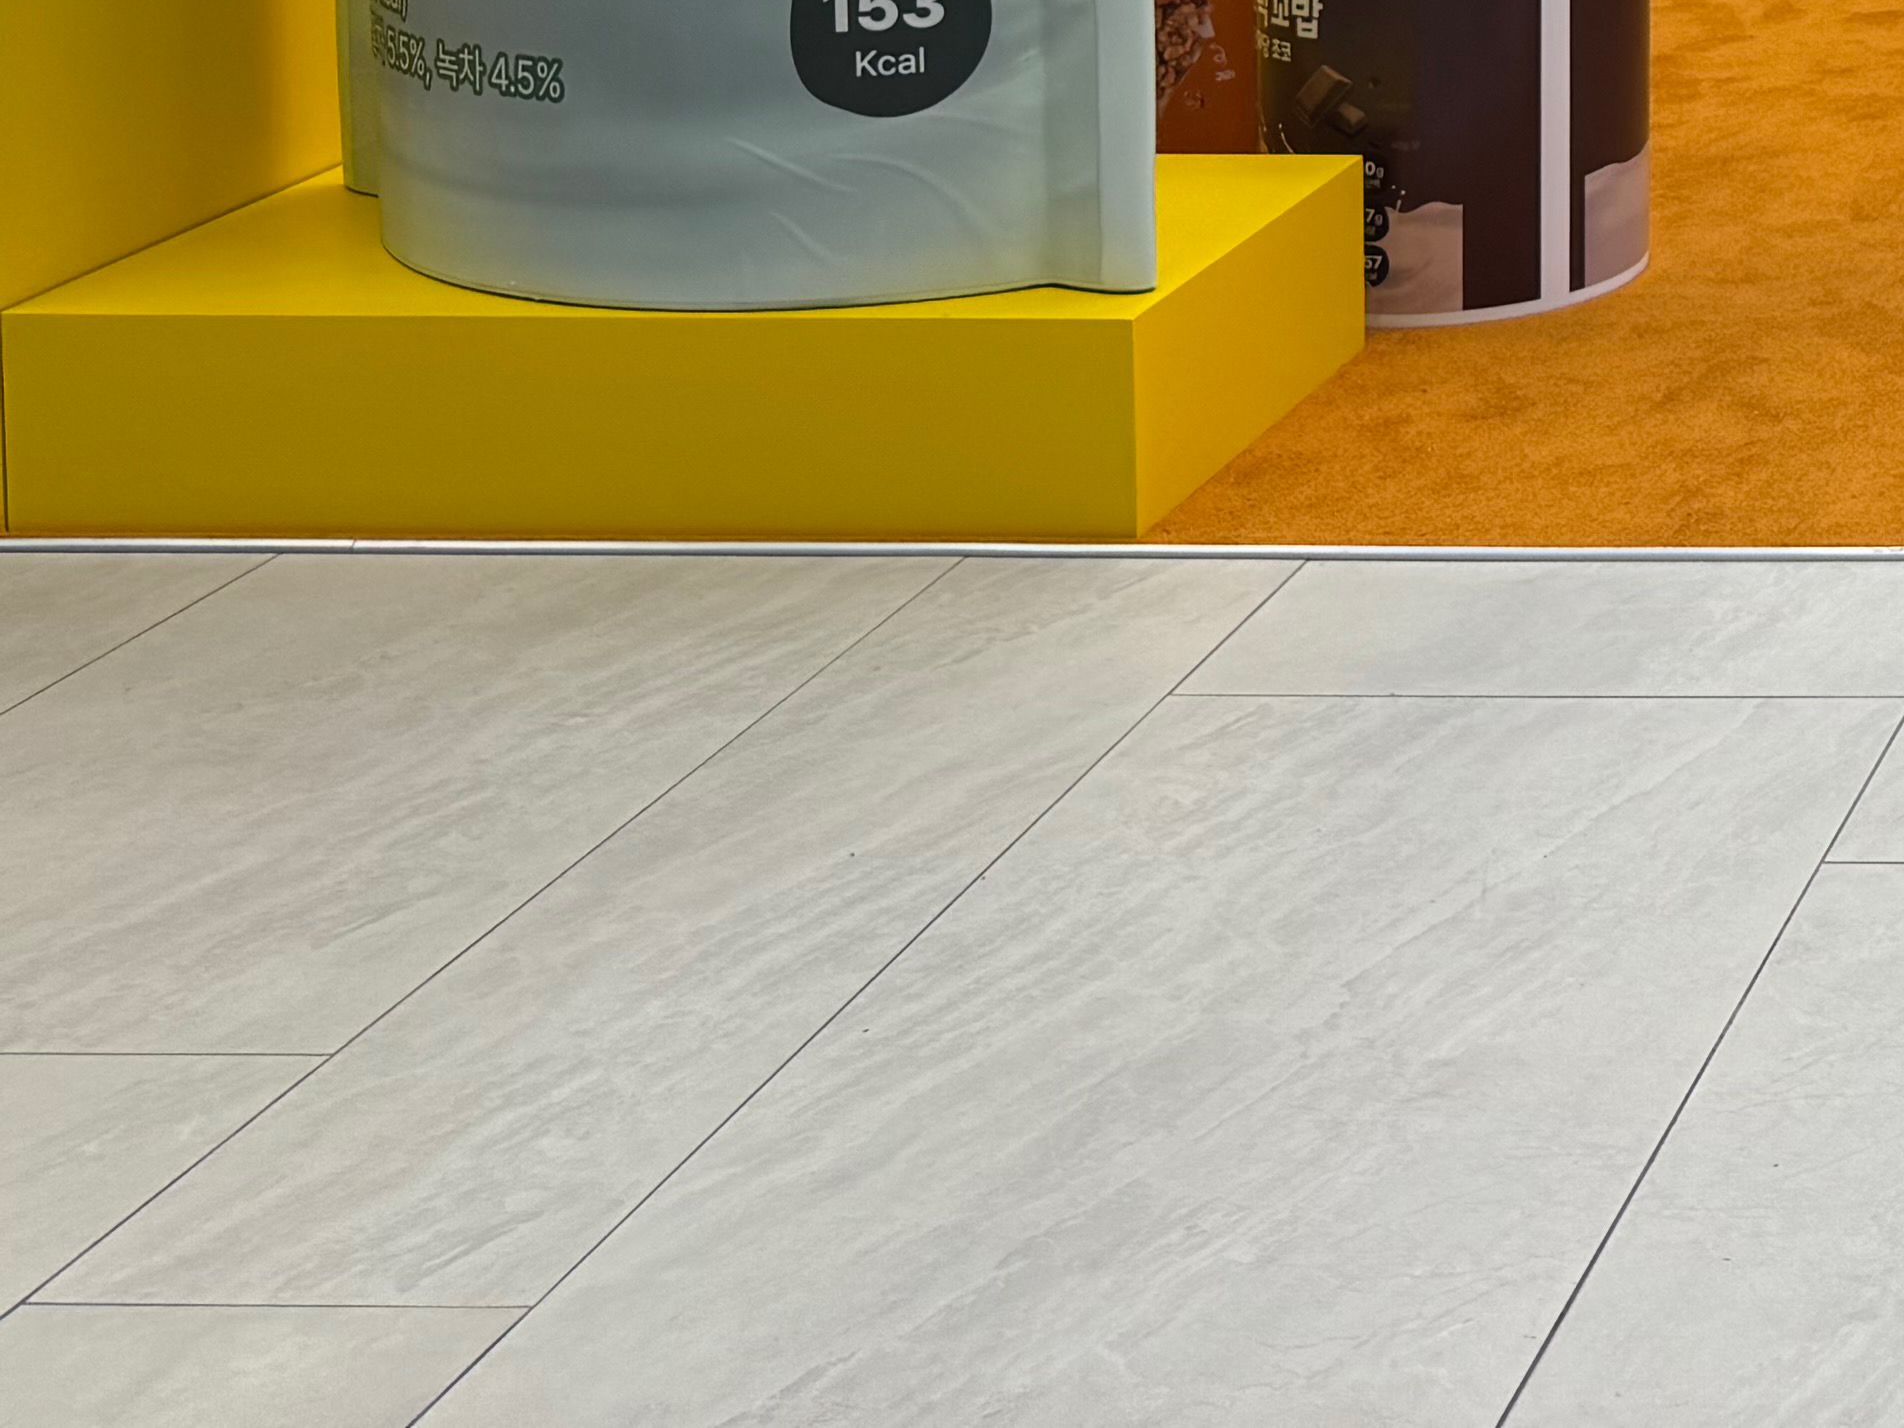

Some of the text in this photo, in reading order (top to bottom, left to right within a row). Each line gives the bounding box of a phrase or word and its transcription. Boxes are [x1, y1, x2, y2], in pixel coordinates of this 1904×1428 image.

[436, 40, 483, 92] 녹차
[490, 54, 562, 100] 4.5%
[854, 45, 926, 79] Kcal
